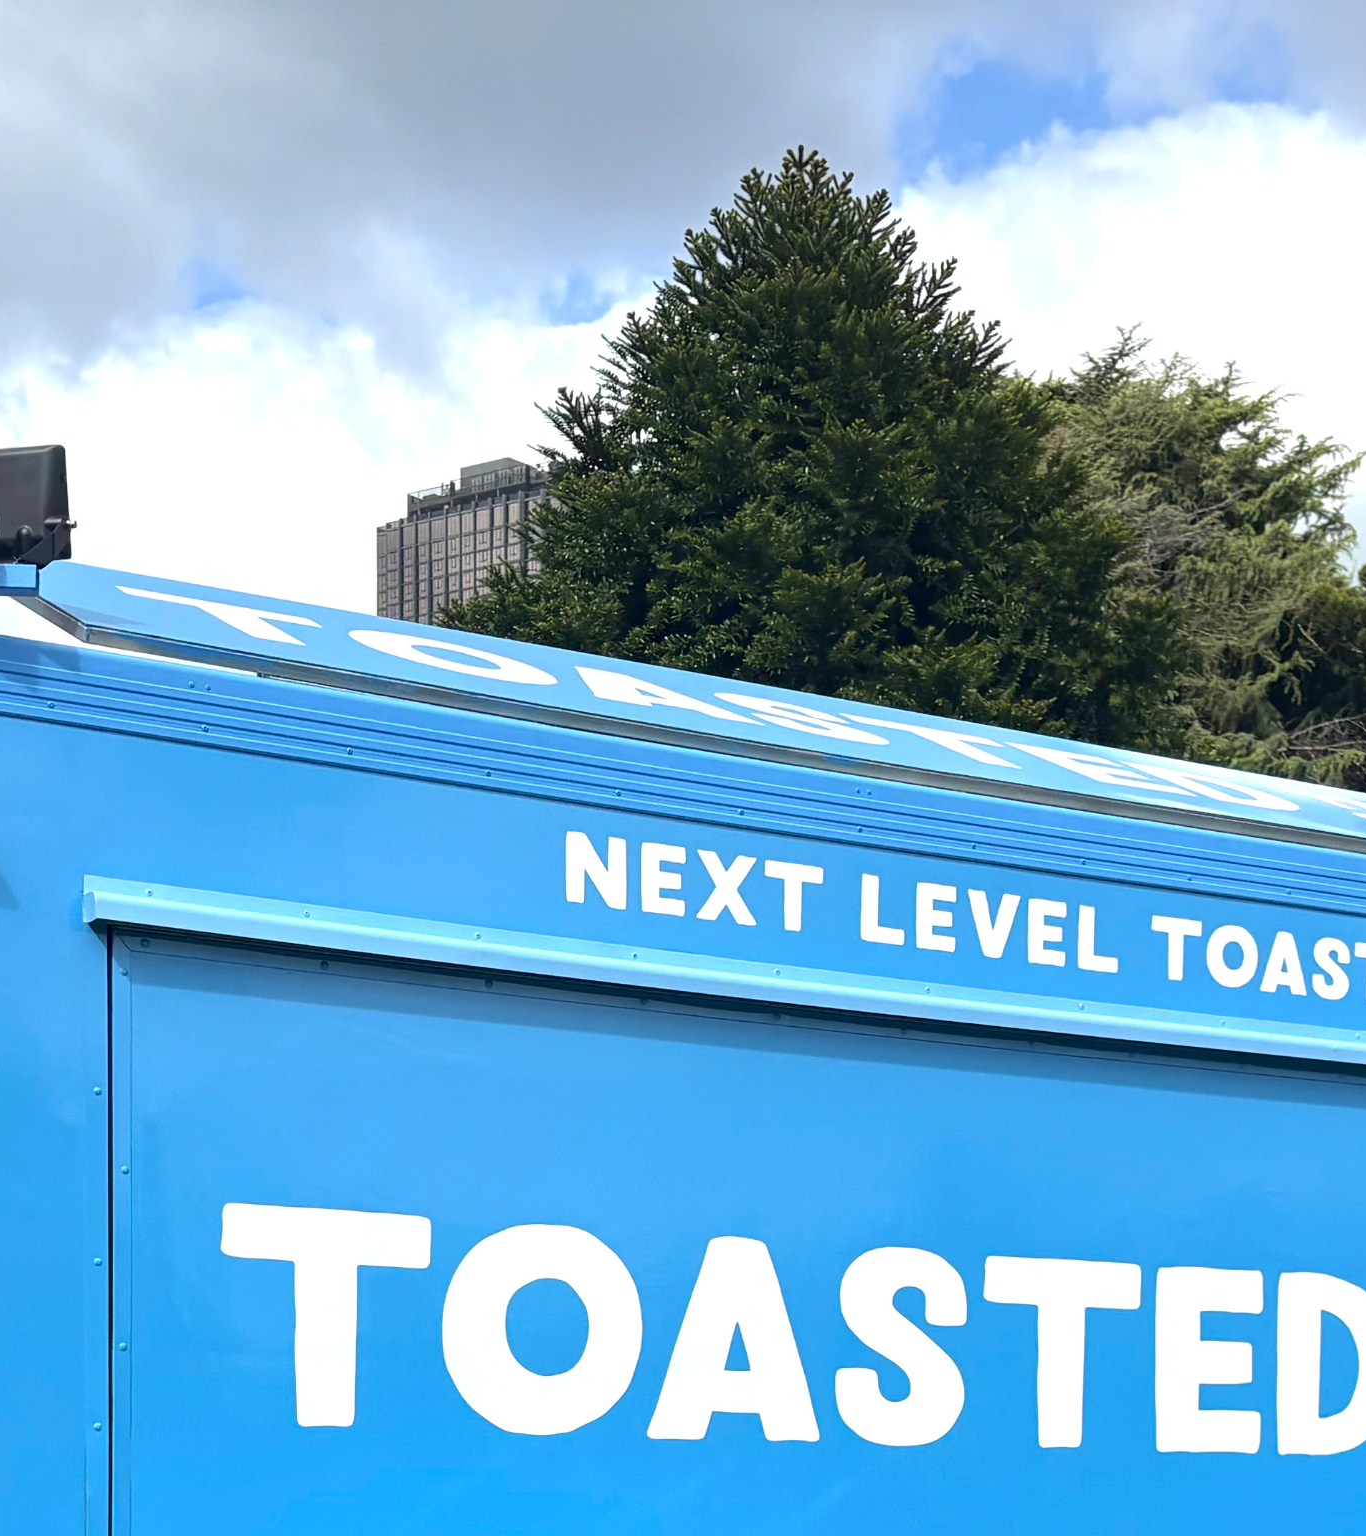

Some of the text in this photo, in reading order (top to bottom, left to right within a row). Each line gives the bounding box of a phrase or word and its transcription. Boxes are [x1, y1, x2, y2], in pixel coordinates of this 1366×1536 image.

[115, 585, 1301, 812] TOASTED
[566, 832, 823, 931] NEXT
[861, 874, 1118, 973] LEVEL
